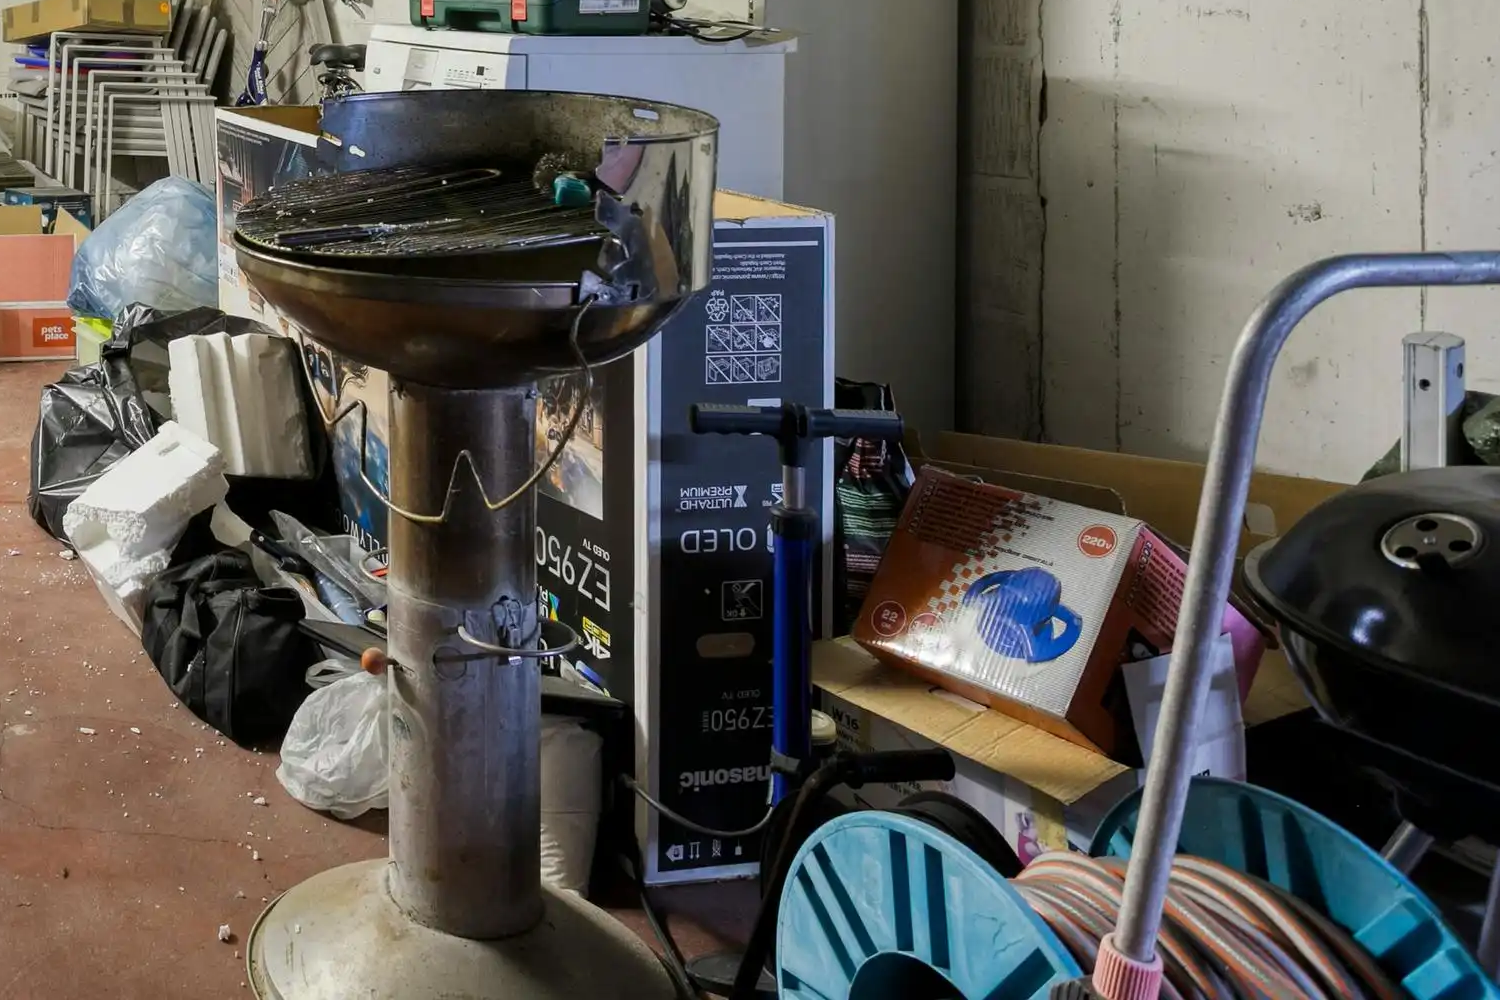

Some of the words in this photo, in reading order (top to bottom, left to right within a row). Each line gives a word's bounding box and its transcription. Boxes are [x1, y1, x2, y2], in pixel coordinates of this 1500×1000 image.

[41, 325, 62, 336] pets
[44, 332, 69, 342] place
[680, 486, 733, 498] PREMIUM
[582, 538, 593, 552] TV
[680, 527, 757, 554] OLED
[592, 544, 610, 562] OLED
[536, 526, 611, 612] EZ950
[583, 628, 611, 660] 4K
[721, 691, 734, 701] TV
[737, 689, 761, 699] OLED
[680, 764, 772, 792] nasonic
